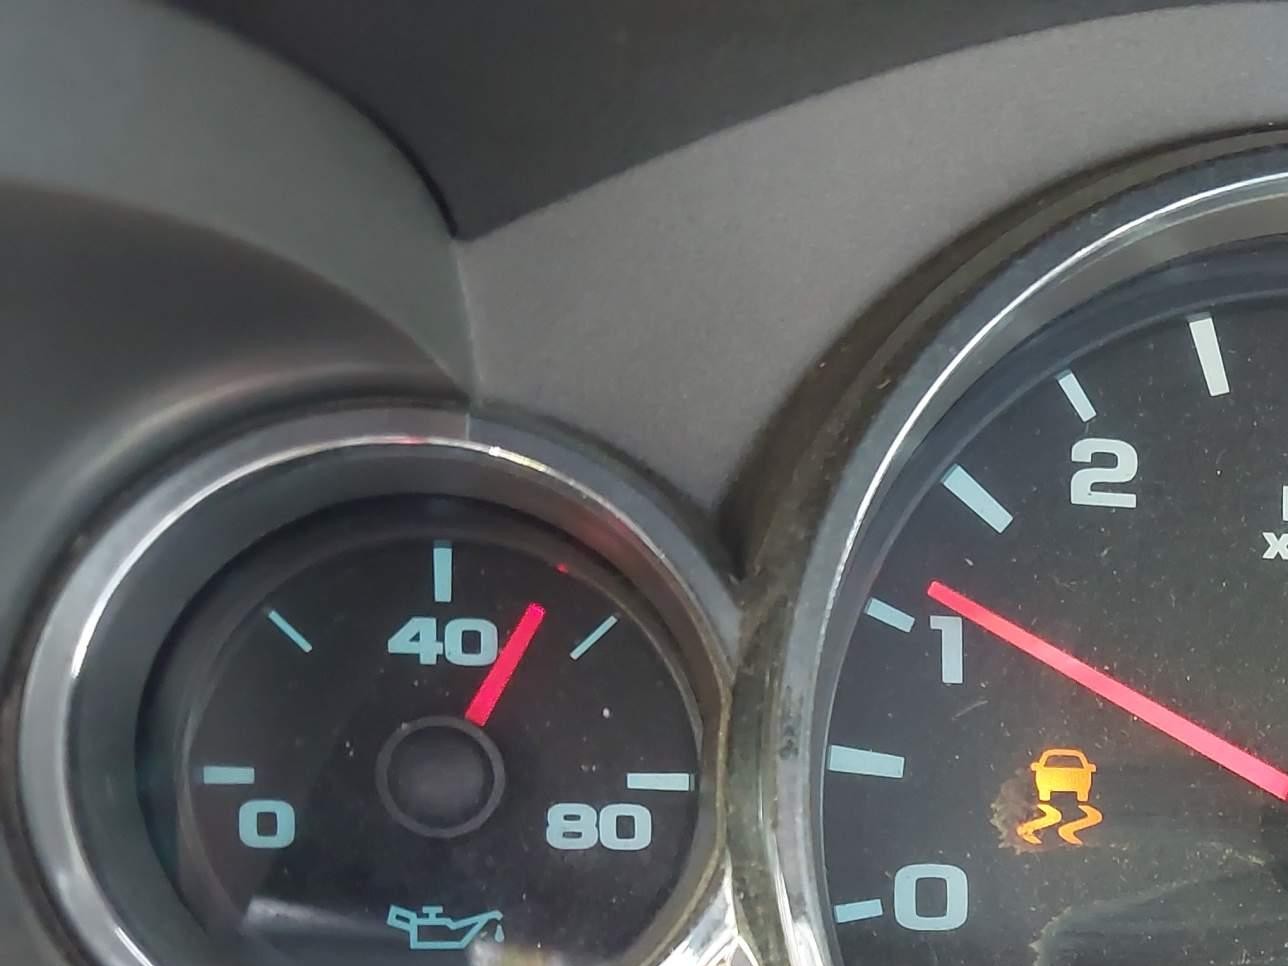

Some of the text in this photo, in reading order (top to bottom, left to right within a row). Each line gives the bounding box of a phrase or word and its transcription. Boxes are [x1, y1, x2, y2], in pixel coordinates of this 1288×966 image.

[1070, 438, 1139, 508] 2
[387, 616, 499, 666] 40
[929, 614, 963, 684] 1
[239, 800, 296, 849] 0
[545, 803, 652, 850] 80
[893, 862, 969, 932] 0
